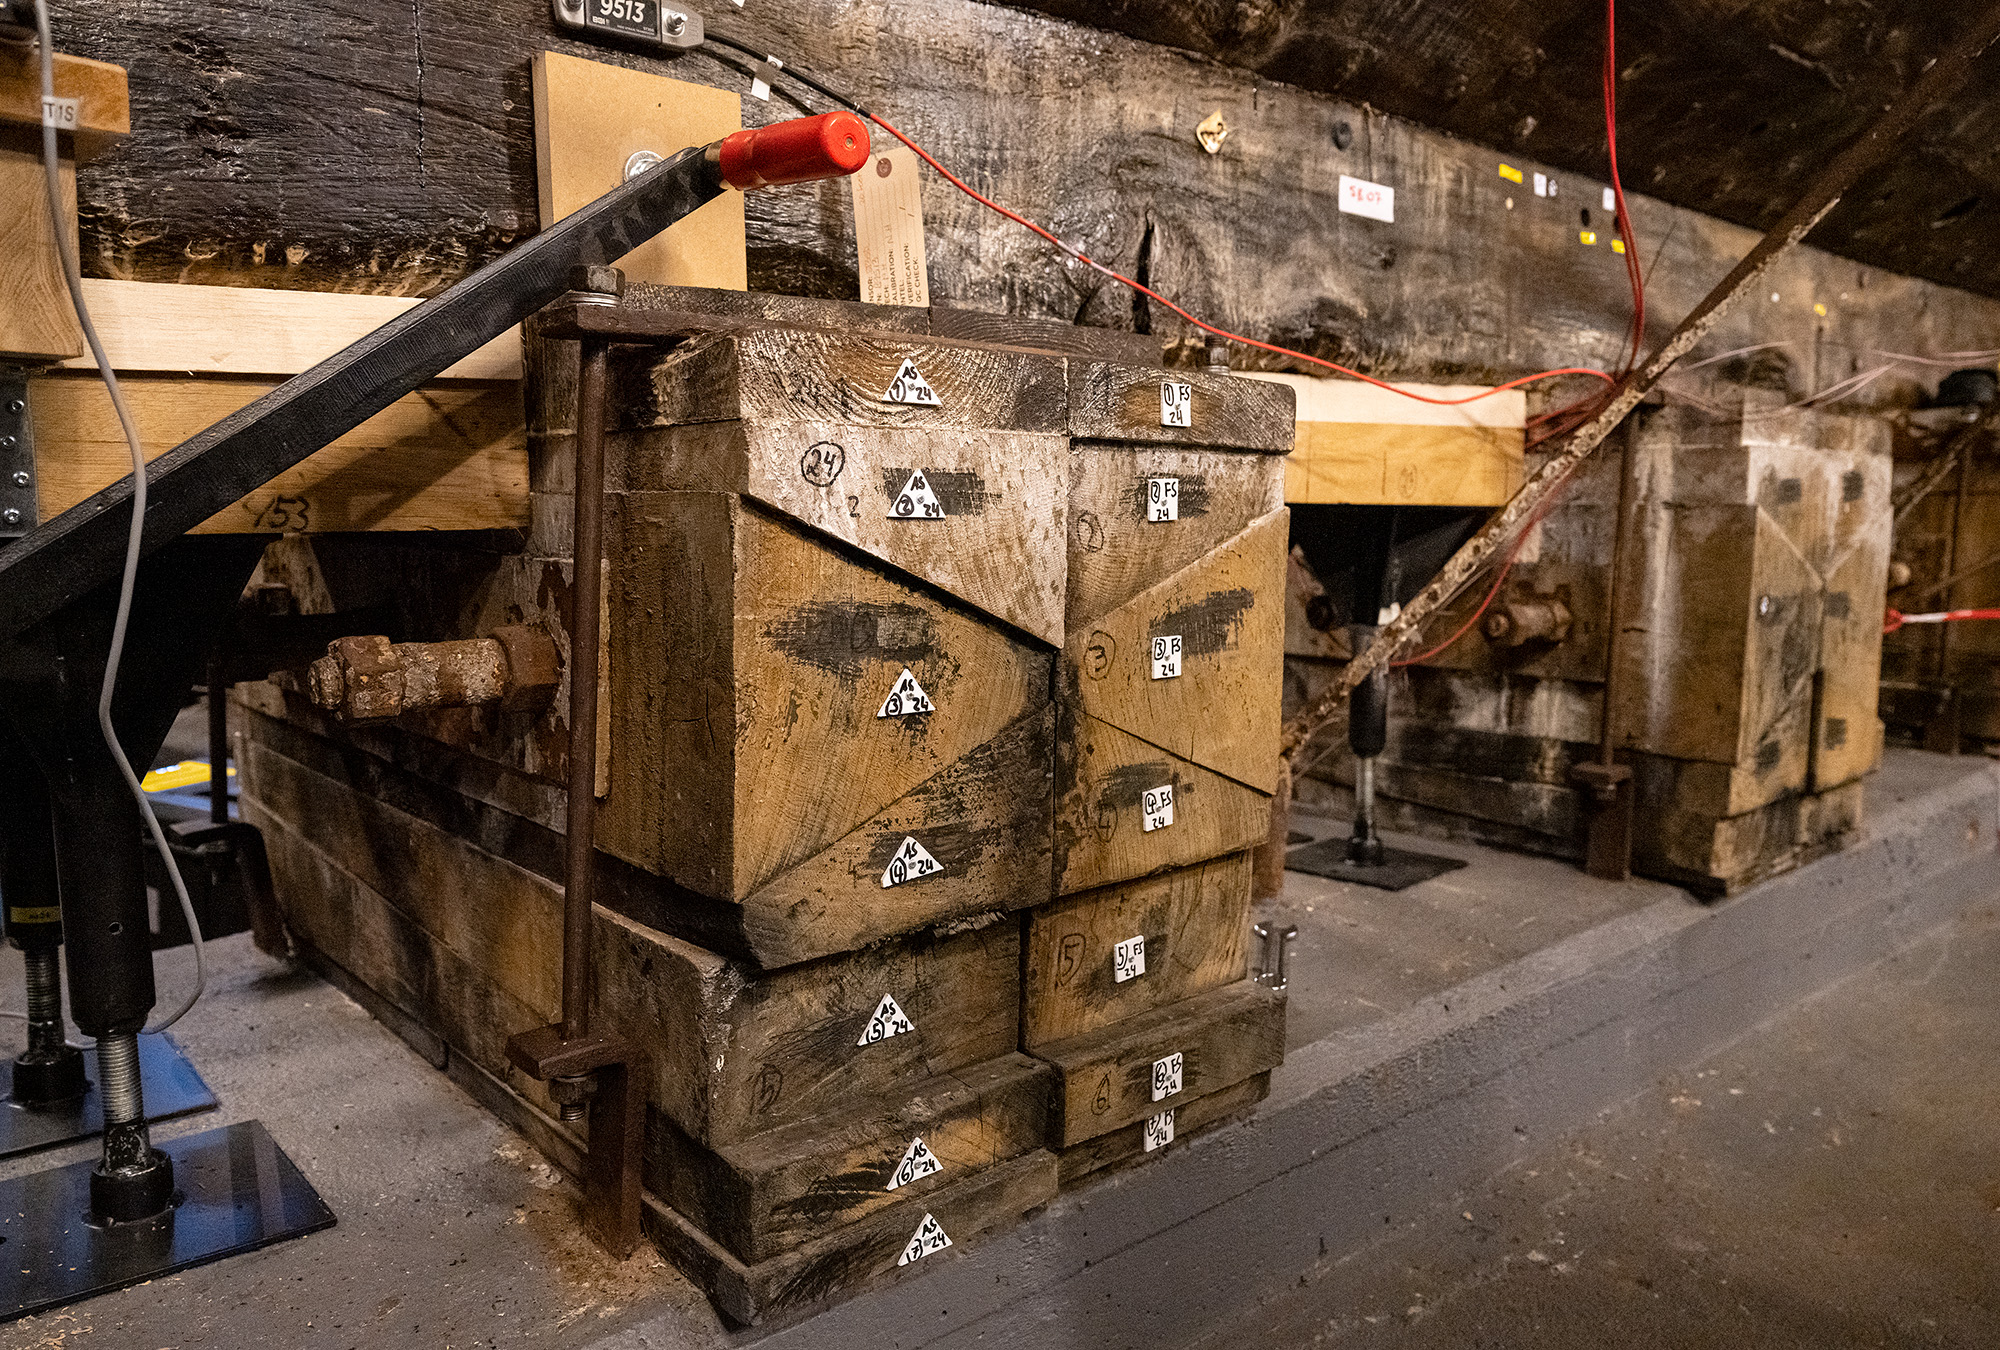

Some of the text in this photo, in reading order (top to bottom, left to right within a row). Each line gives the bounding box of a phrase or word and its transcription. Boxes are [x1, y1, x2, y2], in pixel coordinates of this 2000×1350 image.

[600, 0, 646, 24] 9513
[904, 242, 914, 305] VERIFICATION:
[913, 256, 922, 303] QC CHECK:
[902, 366, 918, 380] AS
[915, 386, 932, 401] 24
[1179, 386, 1190, 401] FS
[1169, 410, 1183, 424] 24
[806, 449, 837, 477] 24
[910, 476, 925, 491] AS
[1165, 482, 1177, 497] FS
[923, 503, 940, 517] 24
[1156, 508, 1169, 520] 24
[1171, 637, 1181, 655] FS
[1161, 663, 1175, 676] 24
[899, 679, 914, 694] AS
[912, 696, 929, 712] 24
[1160, 790, 1171, 808] FS
[1152, 816, 1165, 829] 24
[903, 842, 918, 859] AS
[917, 859, 933, 874] 24
[1133, 941, 1143, 955] FS
[1124, 964, 1136, 977] 24
[880, 1002, 896, 1018] AS
[892, 1020, 909, 1035] 24
[1171, 1055, 1182, 1074] FS
[1162, 1079, 1177, 1097] 24
[1153, 1130, 1167, 1146] 24
[913, 1143, 927, 1160] AS
[922, 1159, 936, 1172] 24
[922, 1218, 937, 1237] AS
[930, 1232, 946, 1248] 24
